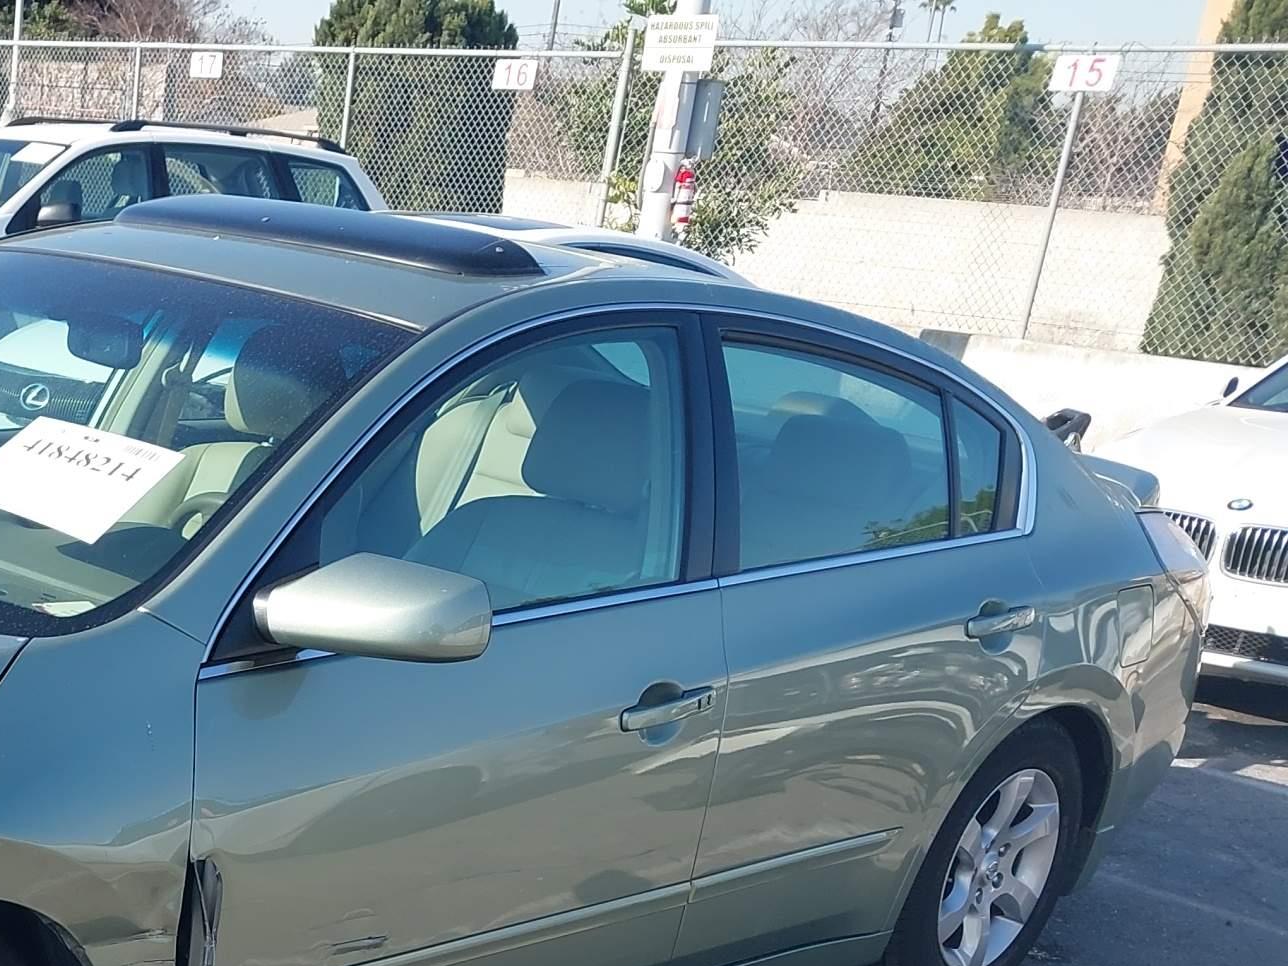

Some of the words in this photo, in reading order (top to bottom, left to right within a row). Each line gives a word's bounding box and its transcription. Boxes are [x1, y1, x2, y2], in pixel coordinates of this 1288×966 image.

[650, 21, 694, 31] HAZARDOUS
[695, 21, 714, 31] SPILL
[198, 54, 217, 74] 17
[659, 55, 694, 64] DISPOSAL
[504, 62, 529, 87] 16
[1066, 57, 1107, 88] 15
[23, 439, 142, 482] 41848214
